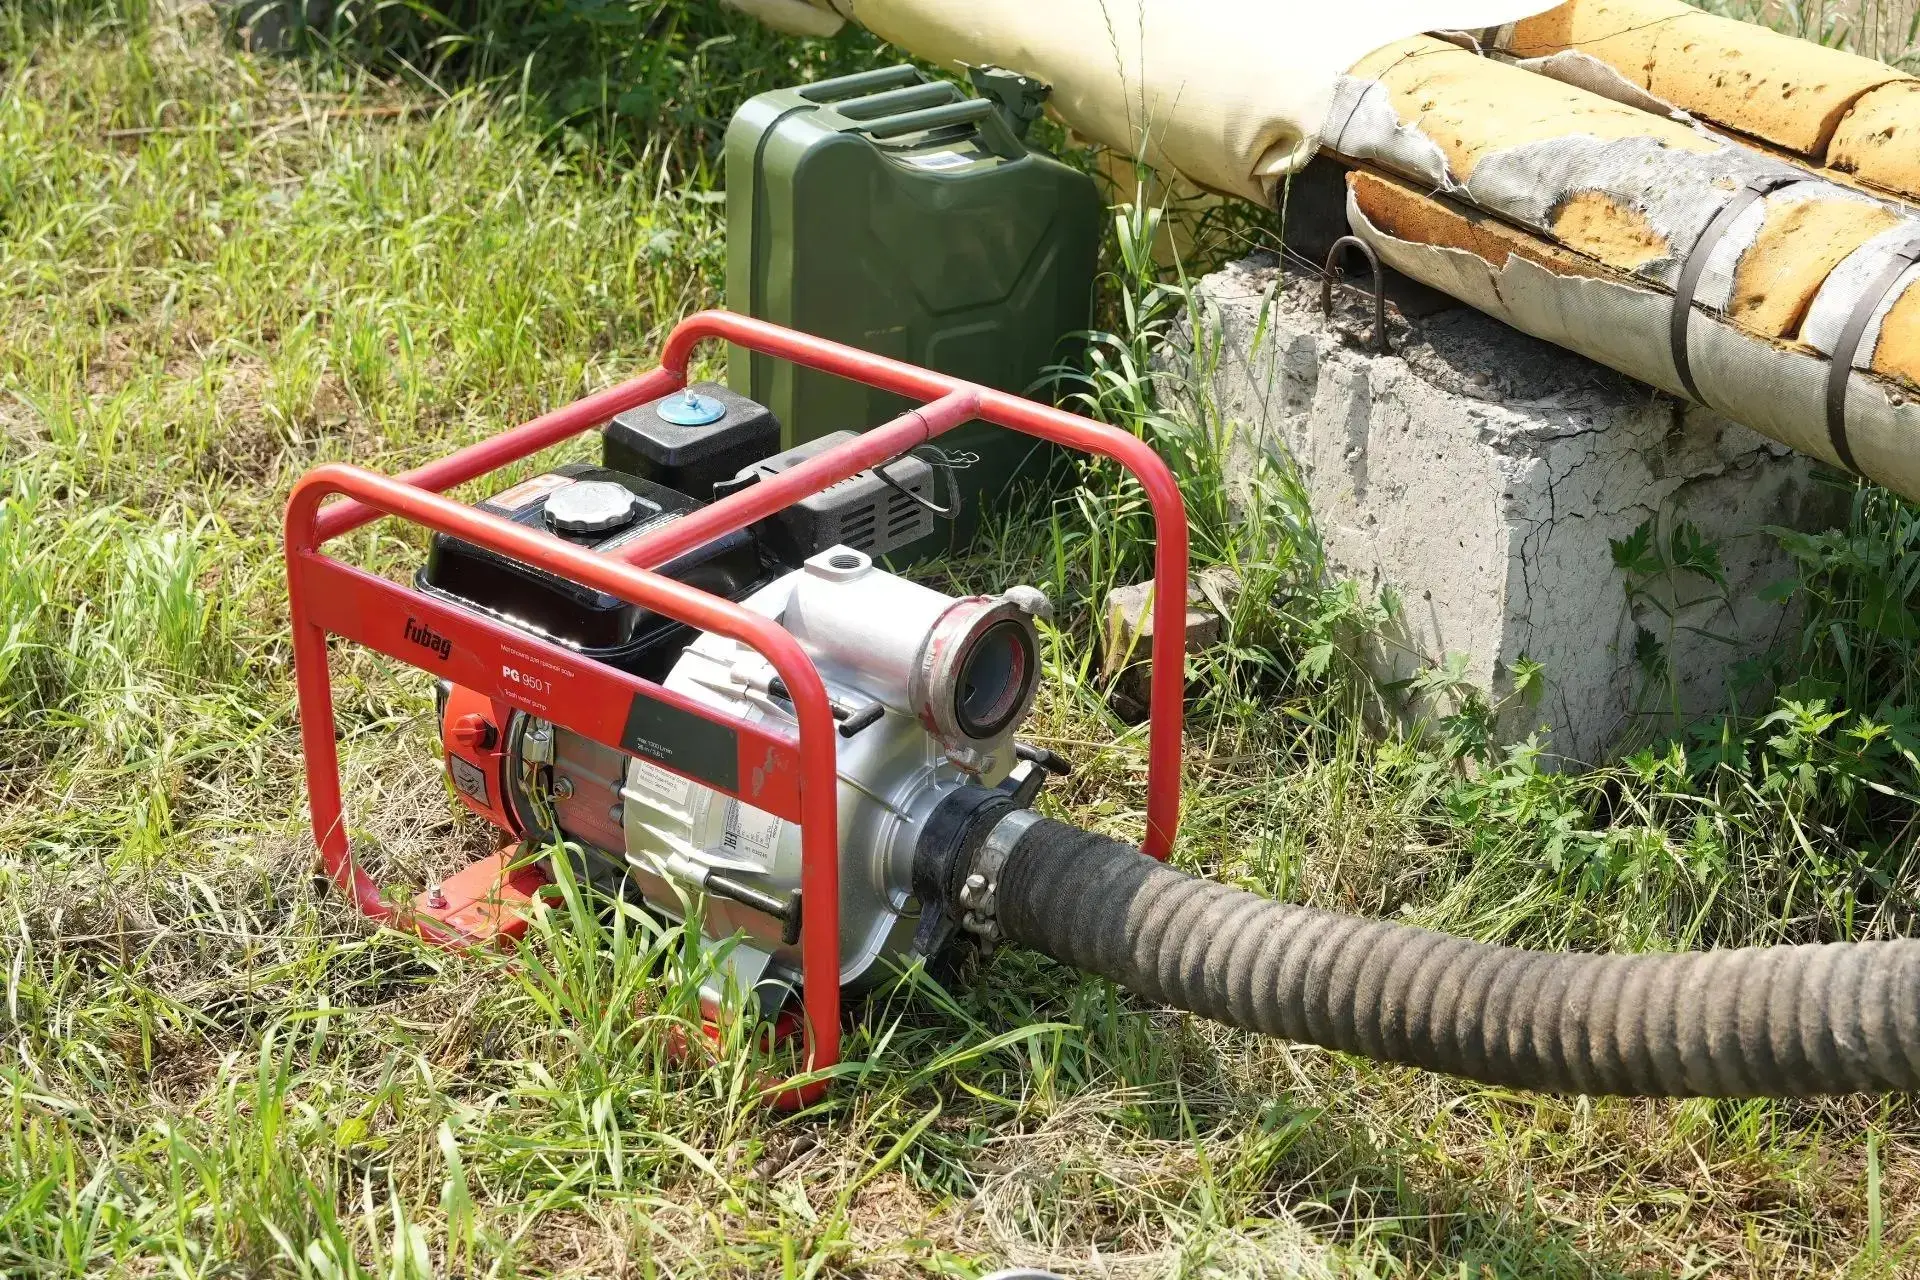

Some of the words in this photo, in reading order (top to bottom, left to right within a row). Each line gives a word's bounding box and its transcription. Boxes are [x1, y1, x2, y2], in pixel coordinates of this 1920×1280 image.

[403, 617, 452, 661] fubag
[530, 656, 540, 665] для
[502, 665, 520, 683] PG
[522, 673, 543, 691] 950
[544, 681, 552, 695] T
